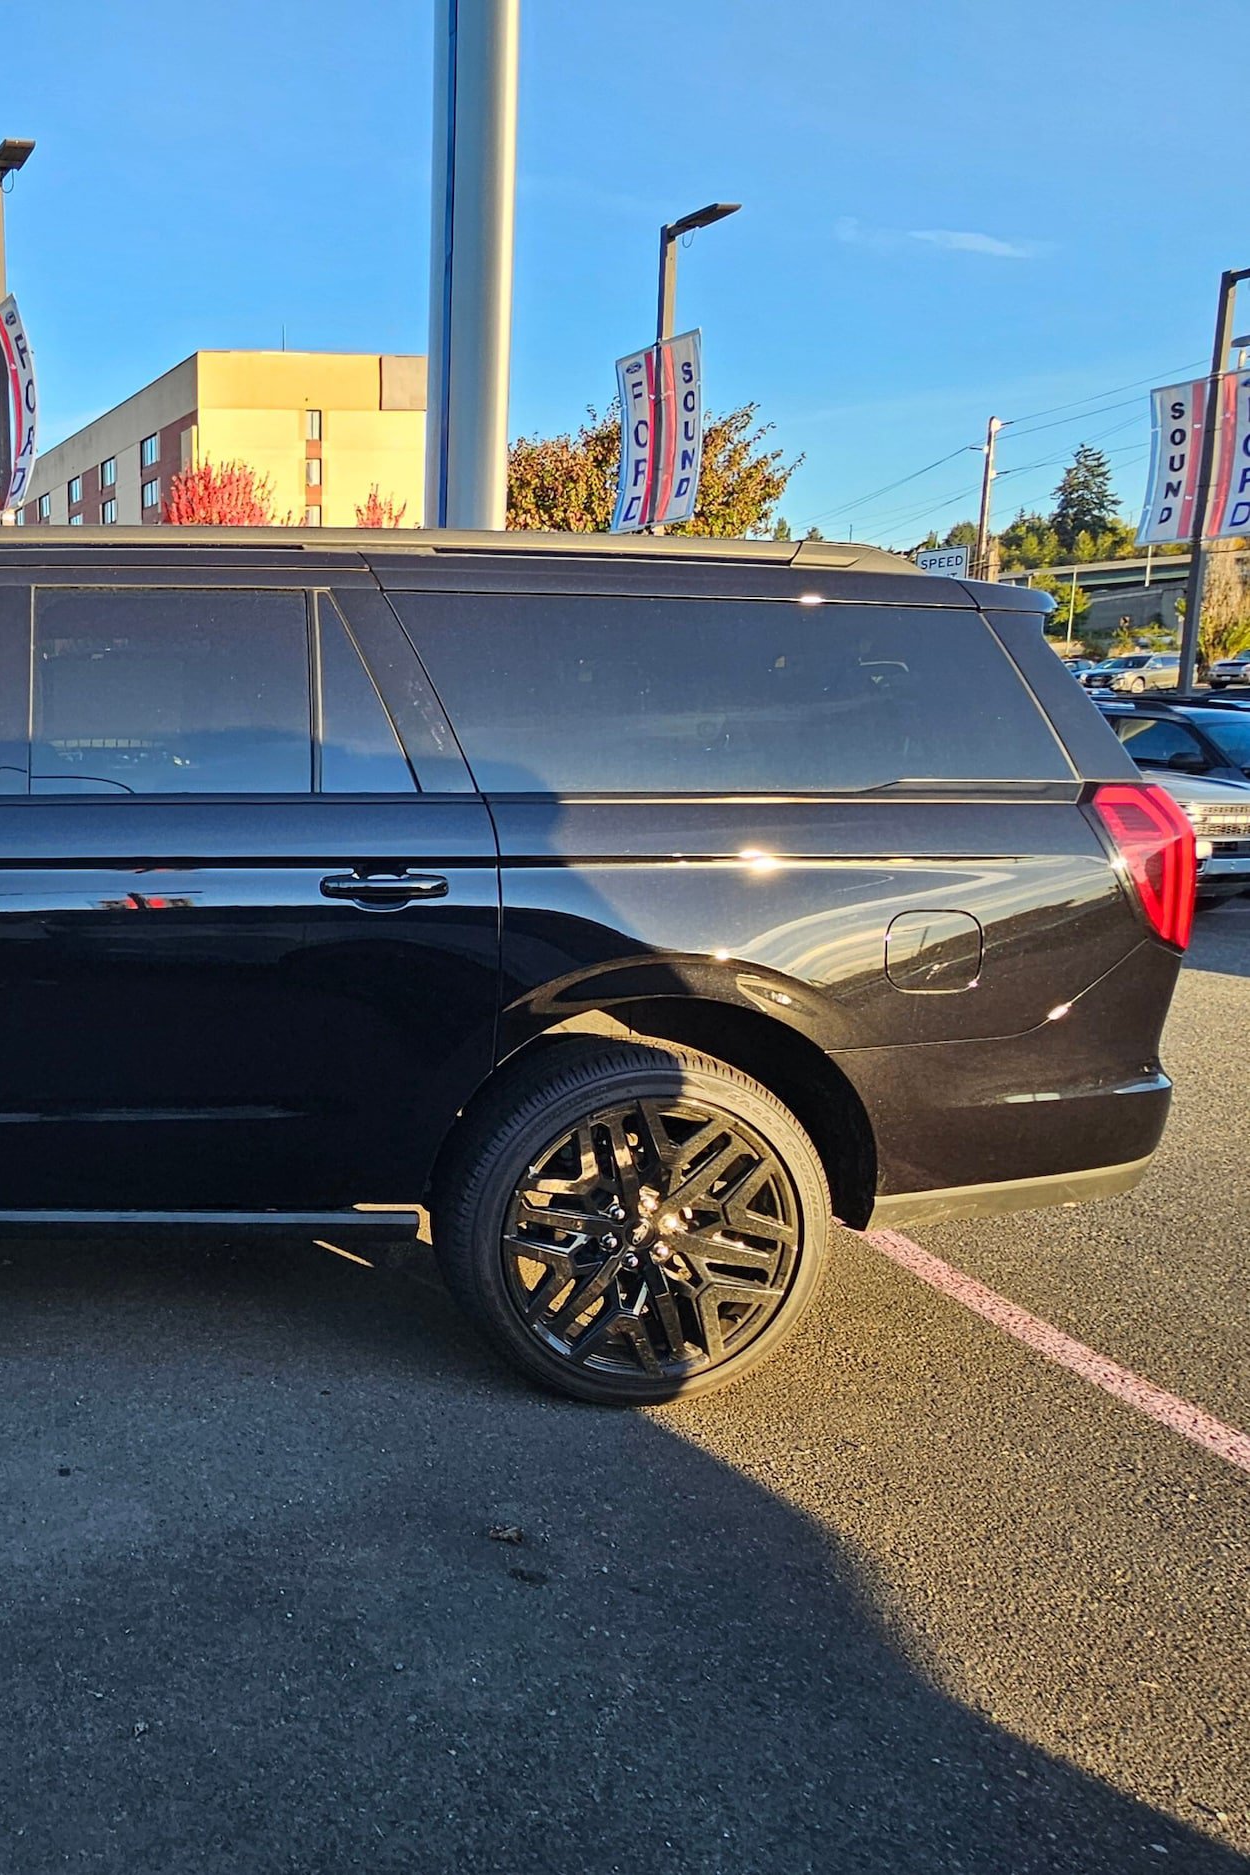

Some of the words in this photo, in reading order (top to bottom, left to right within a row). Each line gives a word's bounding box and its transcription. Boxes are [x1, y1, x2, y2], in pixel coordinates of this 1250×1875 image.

[674, 361, 695, 499] SOUND
[1158, 401, 1186, 525] SOUND
[920, 554, 963, 570] SPEED
